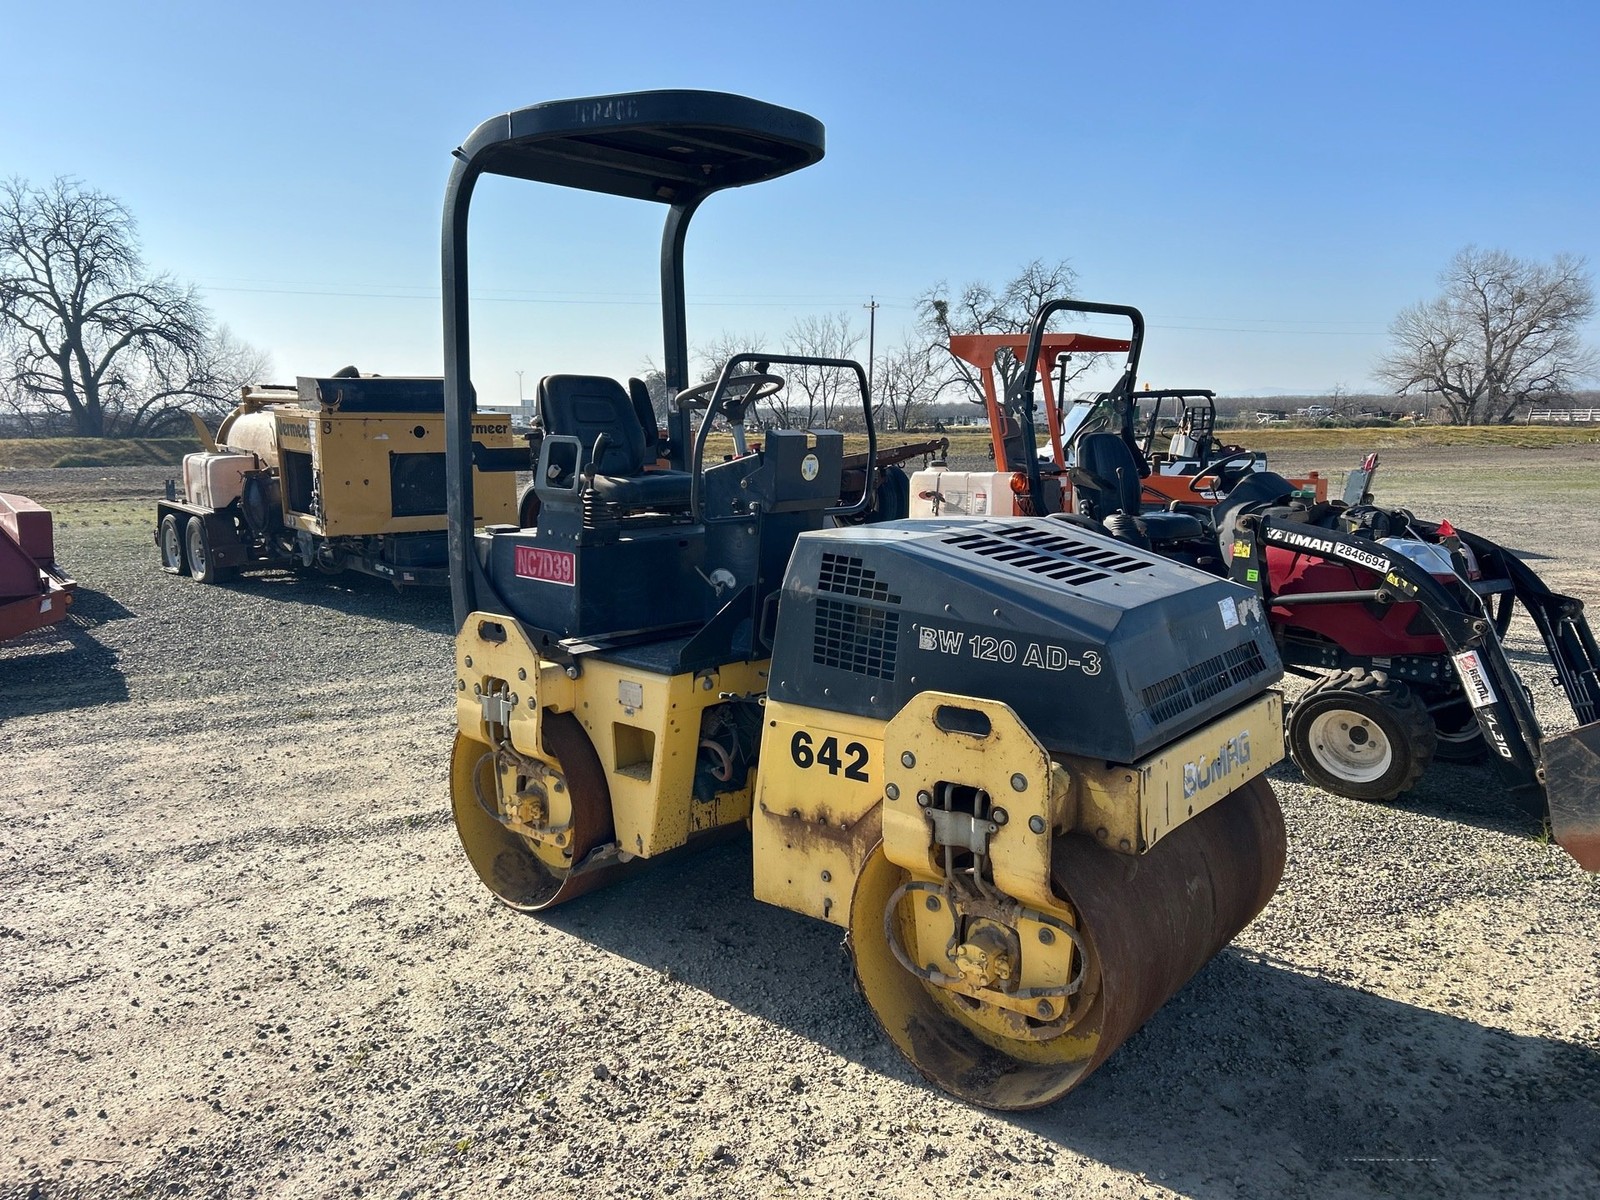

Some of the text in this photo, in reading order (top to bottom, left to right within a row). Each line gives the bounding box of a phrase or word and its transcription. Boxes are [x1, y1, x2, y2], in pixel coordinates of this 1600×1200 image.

[471, 424, 508, 434] rmeer
[1266, 527, 1334, 554] YANMAR
[517, 549, 571, 580] NC7D39
[1338, 544, 1386, 569] 2846694
[919, 626, 1102, 676] BW 120 AD-3
[1469, 668, 1489, 702] RENTAL
[791, 730, 869, 783] 642
